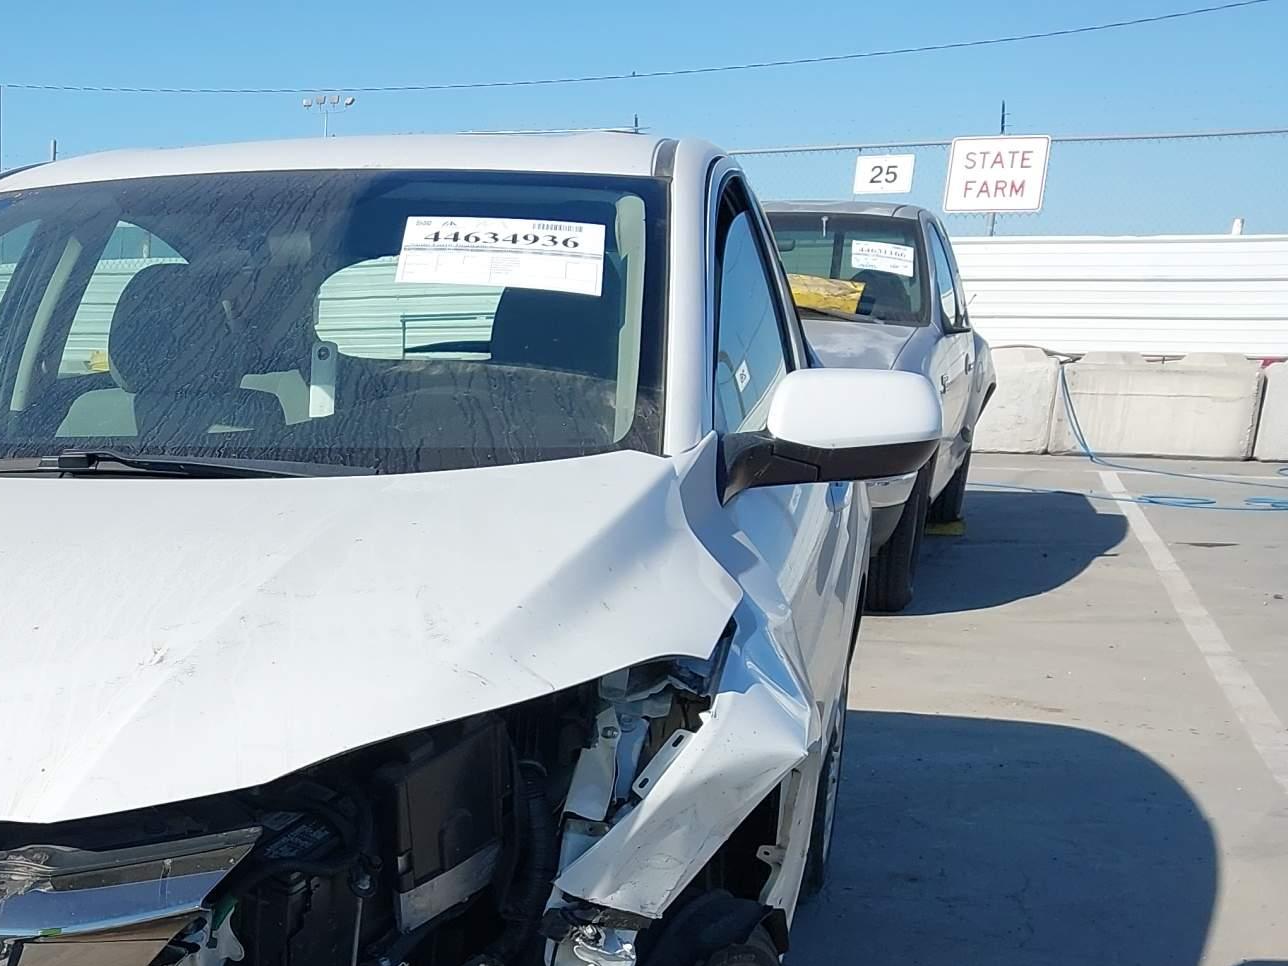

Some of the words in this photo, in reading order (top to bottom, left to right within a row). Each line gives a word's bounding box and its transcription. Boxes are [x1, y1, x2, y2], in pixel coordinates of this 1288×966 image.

[963, 150, 1035, 170] STATE
[869, 165, 899, 184] 25
[963, 180, 1027, 199] FARM
[423, 230, 580, 249] 44634936
